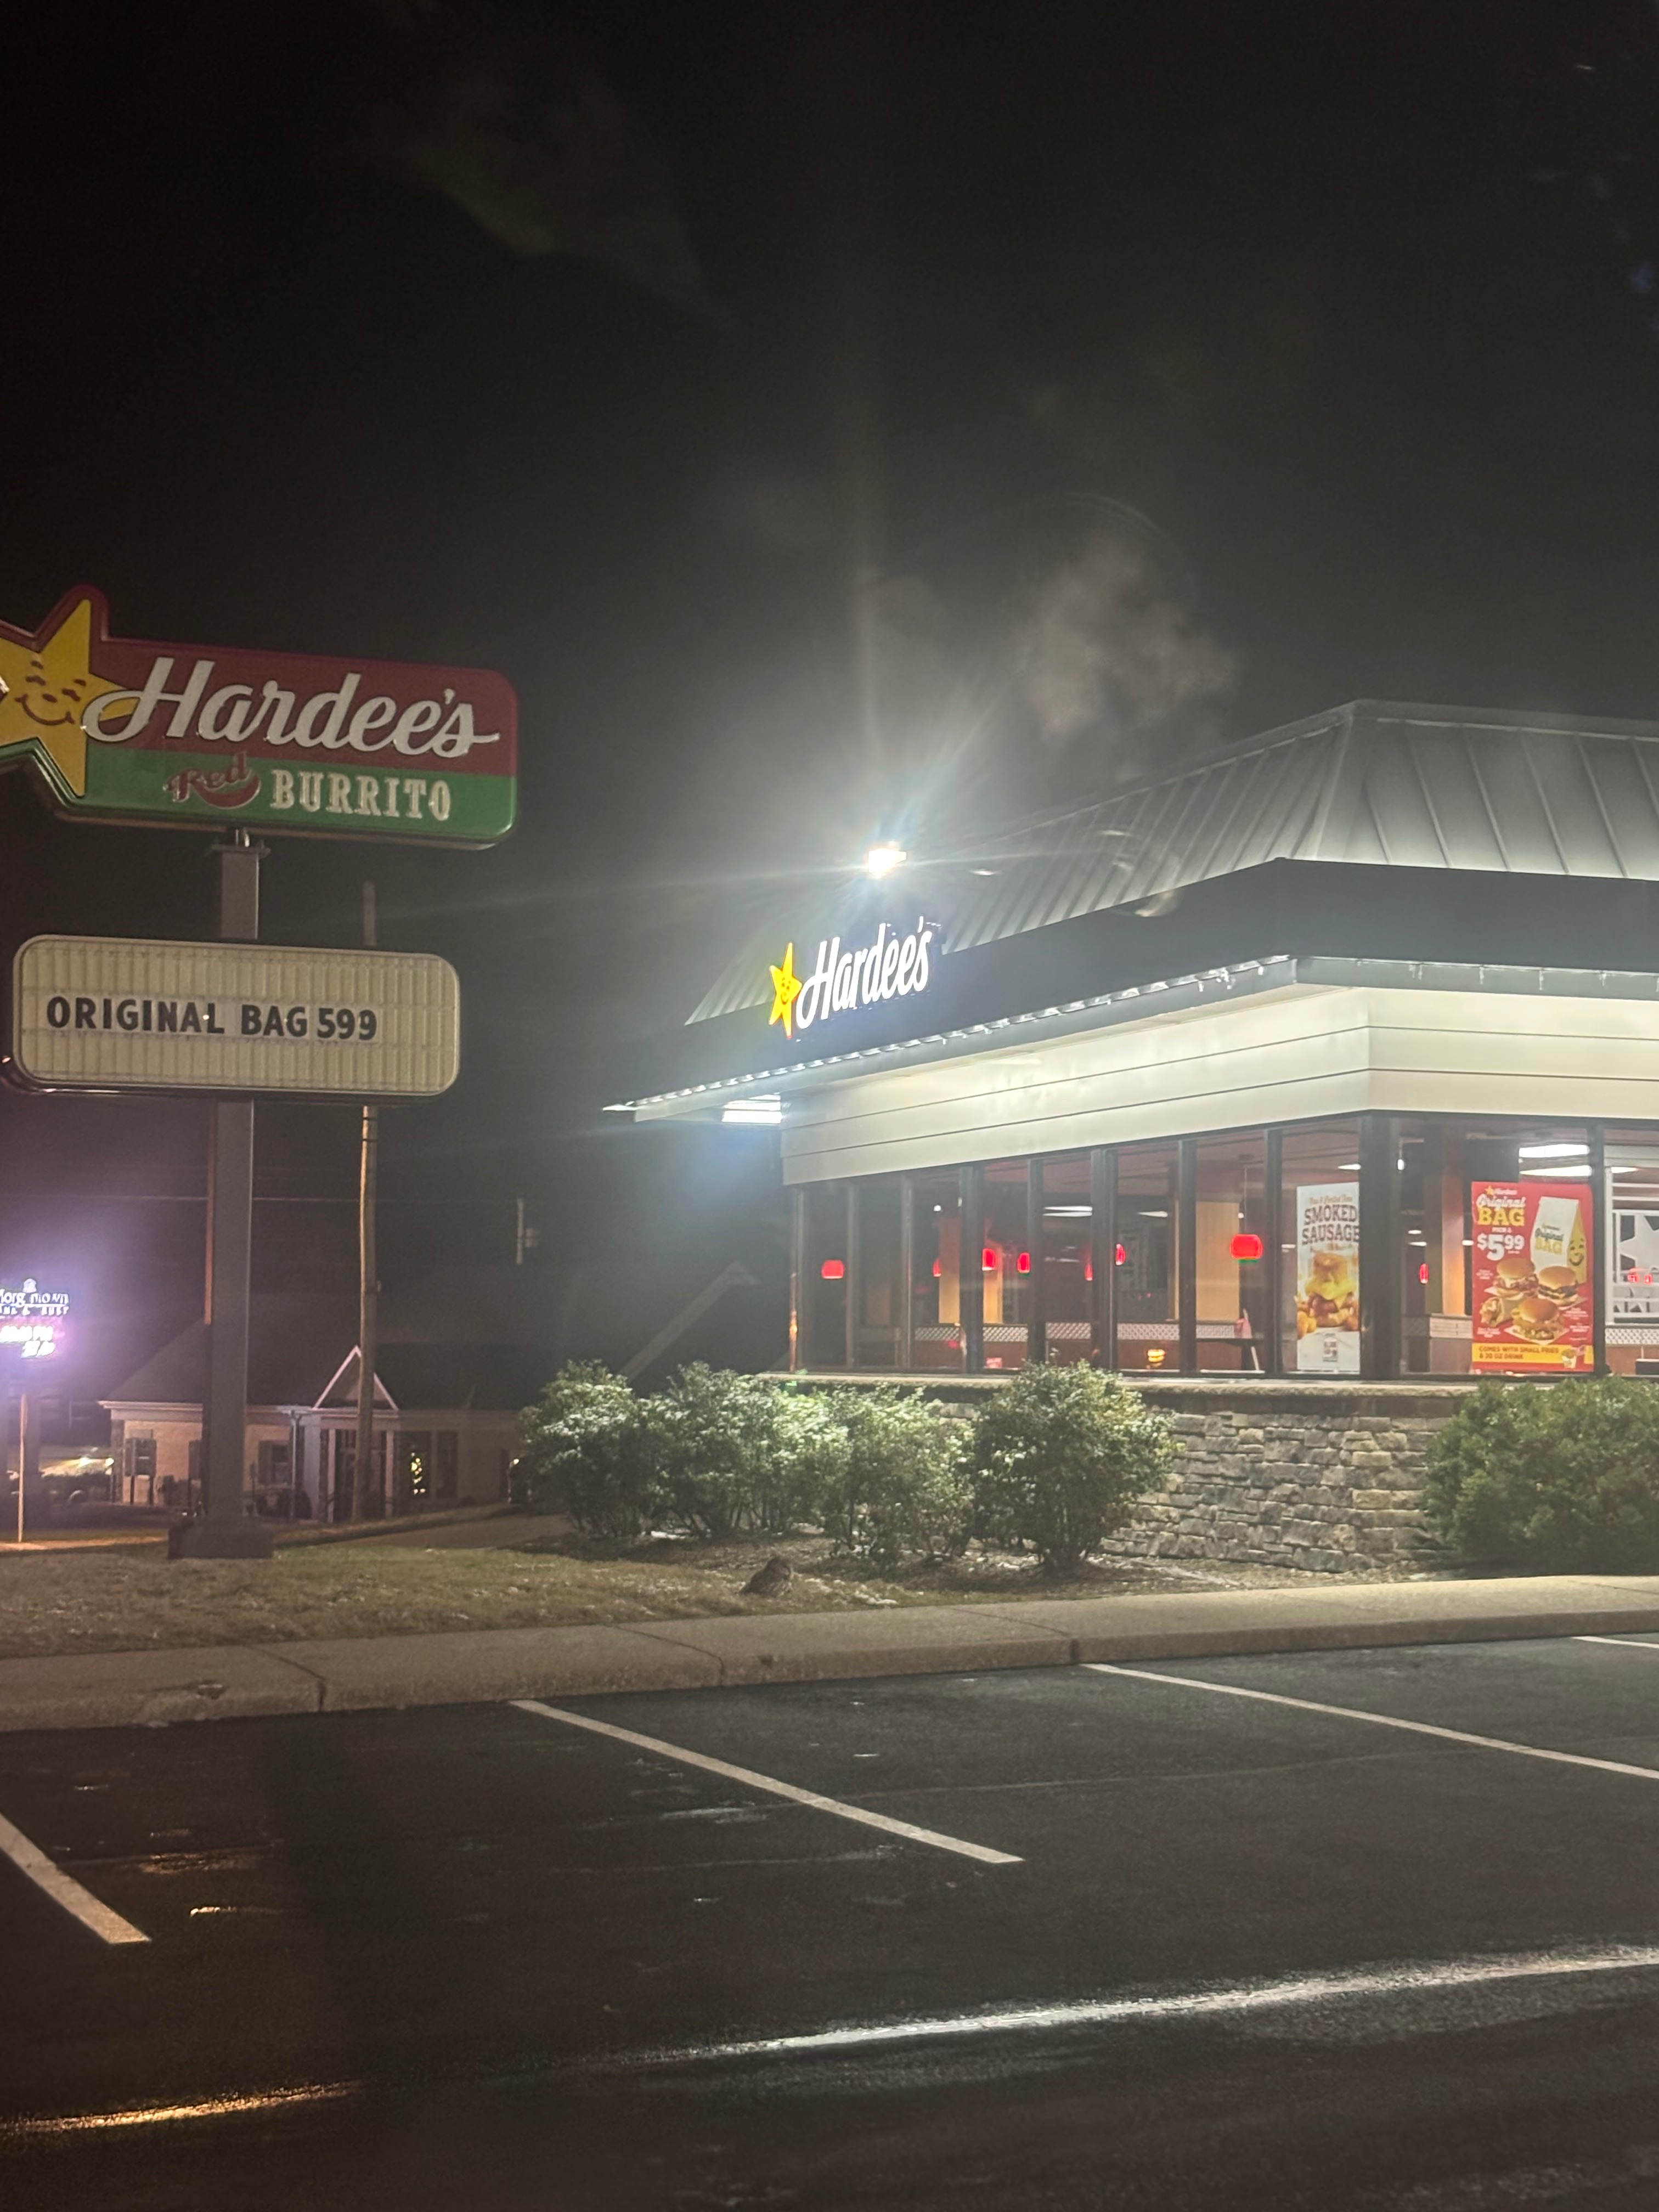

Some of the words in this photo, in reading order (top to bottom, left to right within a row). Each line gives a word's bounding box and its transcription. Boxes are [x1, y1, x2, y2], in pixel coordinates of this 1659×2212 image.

[81, 656, 500, 758] Hardee's
[163, 751, 261, 809] Red
[271, 769, 451, 821] BURRITO
[796, 916, 933, 1029] Hardee's
[47, 996, 225, 1035] ORIGINAL
[241, 1004, 308, 1037] BAG
[317, 1008, 377, 1041] 599
[1302, 1223, 1359, 1245] SAUSAGE
[1305, 1204, 1357, 1225] SMOKED
[1477, 1207, 1525, 1226] BAG
